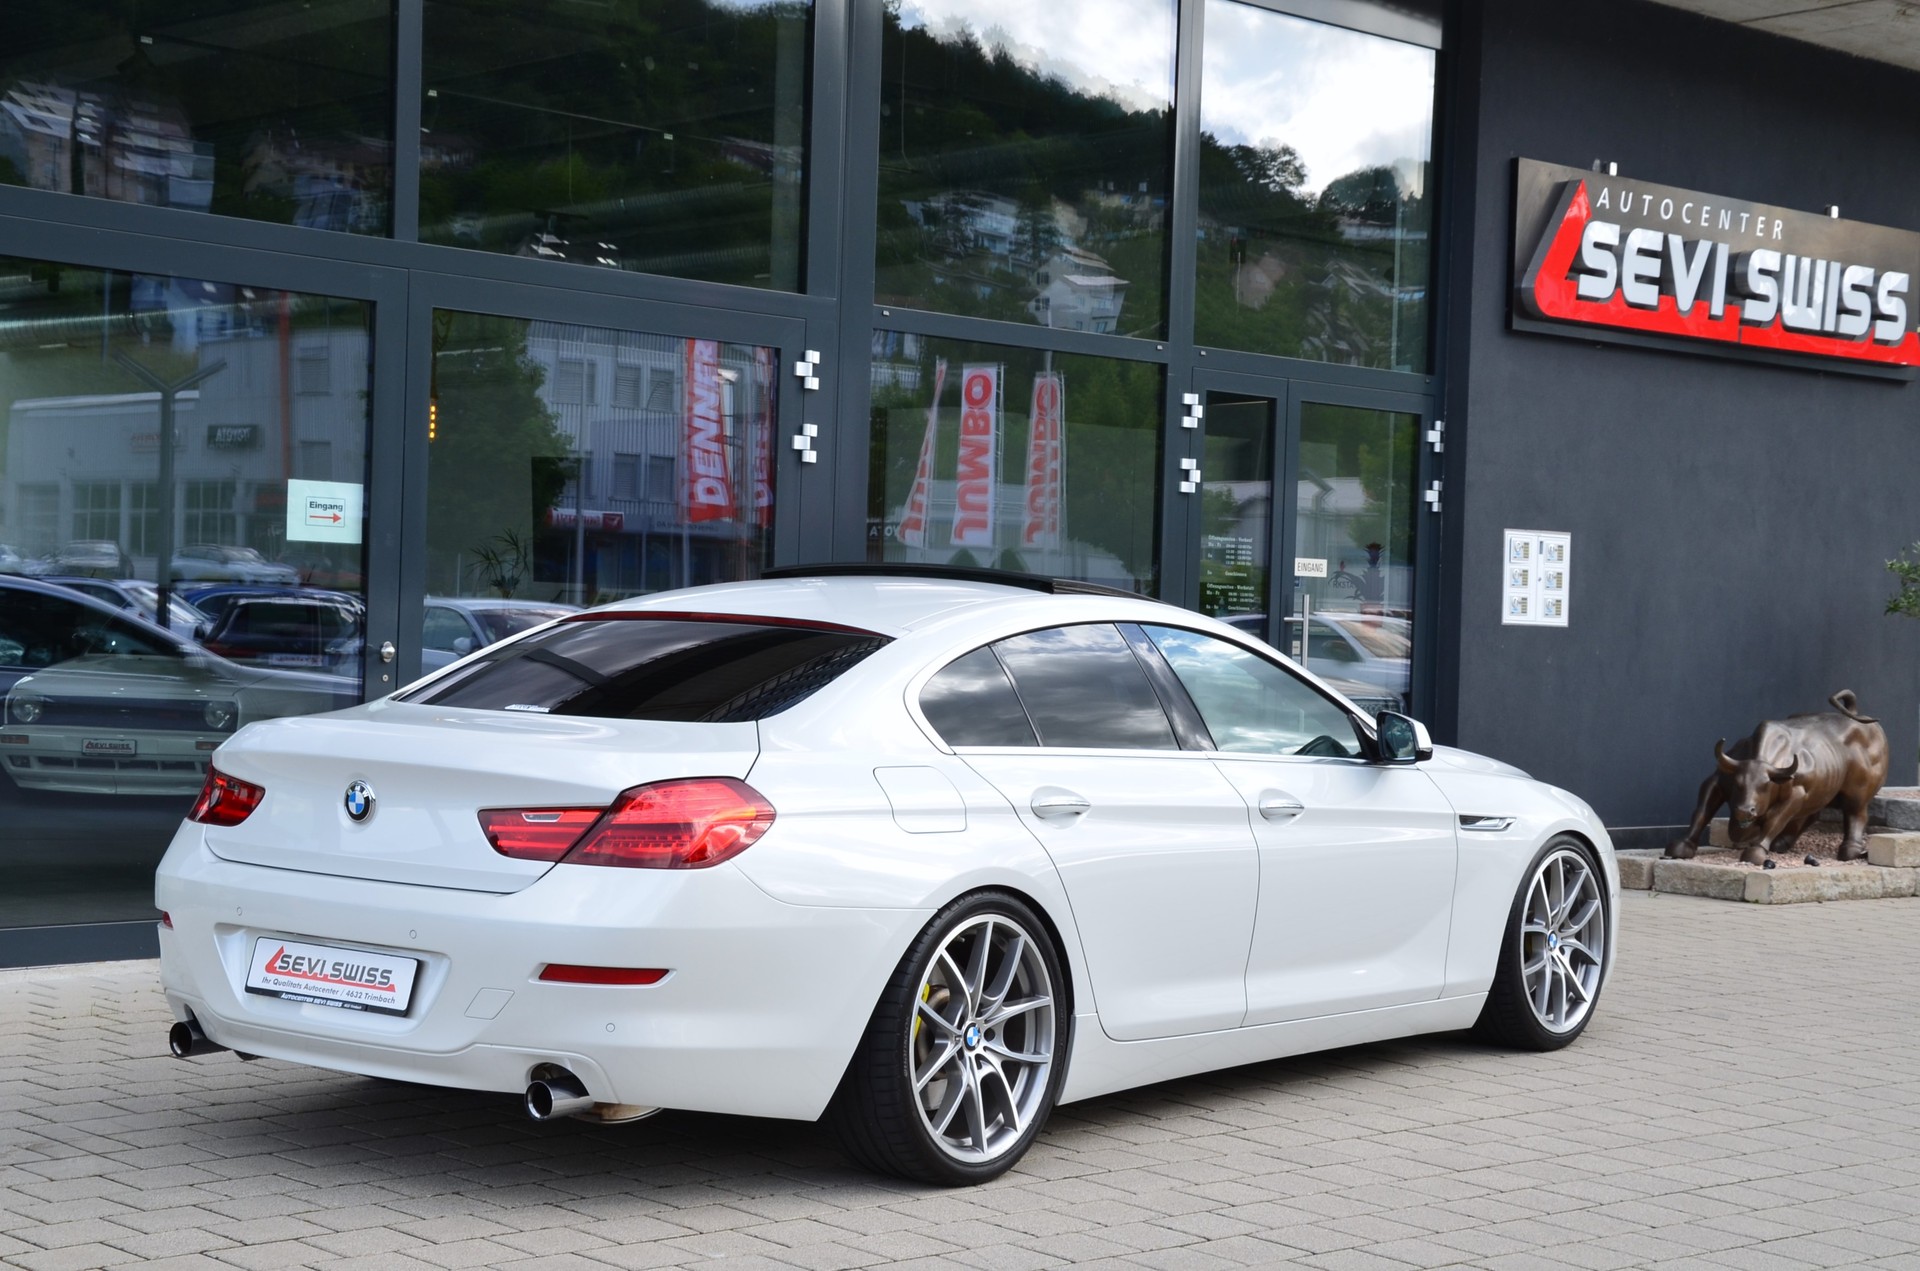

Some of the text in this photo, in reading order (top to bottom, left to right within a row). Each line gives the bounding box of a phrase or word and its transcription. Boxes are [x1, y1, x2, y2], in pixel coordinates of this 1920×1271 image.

[1596, 187, 1783, 240] AUTOCENTER
[1576, 220, 1910, 342] SEVI SWISS
[691, 340, 729, 506] DENNER
[308, 500, 344, 512] Eingang
[1297, 562, 1324, 572] EINGANG
[277, 954, 393, 986] SEVI SWISS
[262, 976, 272, 985] Ihr
[303, 982, 340, 996] Autocenter
[346, 990, 363, 999] 4632
[364, 992, 396, 1004] Trimbach
